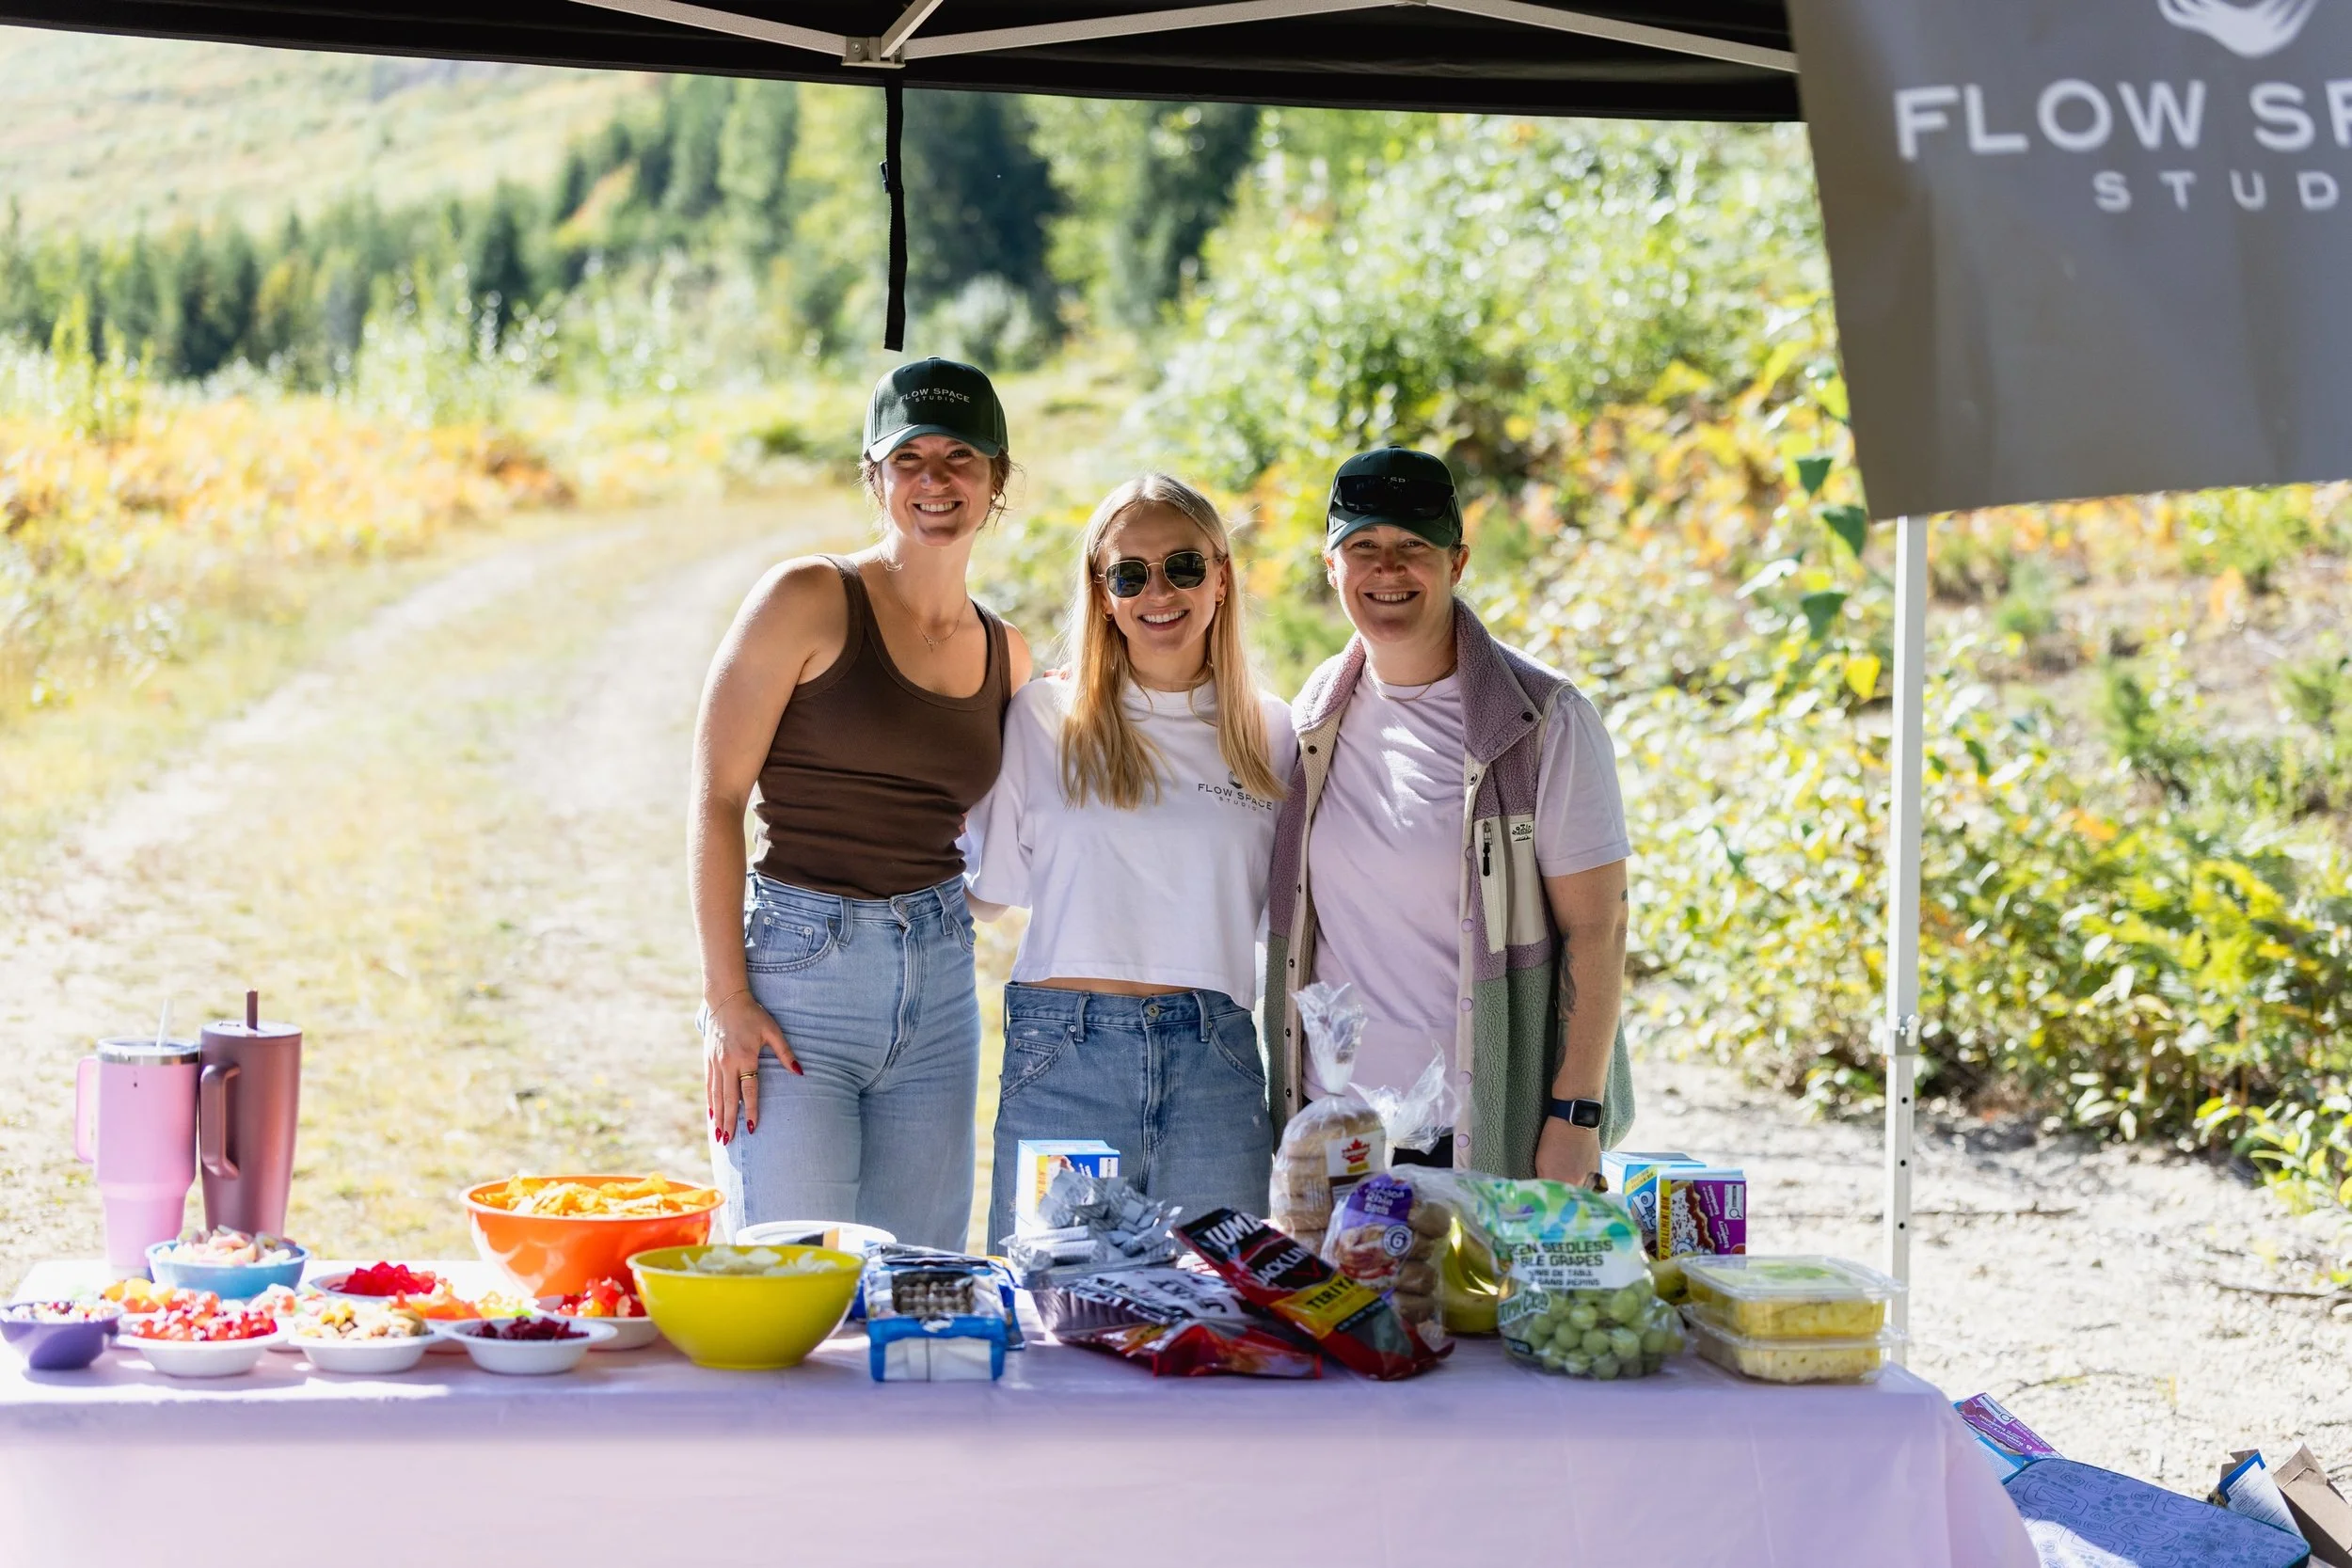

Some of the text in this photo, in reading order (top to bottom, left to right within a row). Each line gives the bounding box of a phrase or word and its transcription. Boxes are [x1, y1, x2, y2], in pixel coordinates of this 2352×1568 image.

[1893, 78, 2208, 162] FLOW
[2093, 168, 2340, 213] STUD
[900, 388, 971, 404] FLOW SPACE
[915, 395, 956, 404] STUDIO
[1198, 783, 1273, 811] FLOW SPACE
[1219, 797, 1257, 811] STUDIO
[1391, 1233, 1404, 1248] 6
[1541, 1240, 1613, 1253] SEEDLESS
[1549, 1254, 1605, 1267] GRAPES
